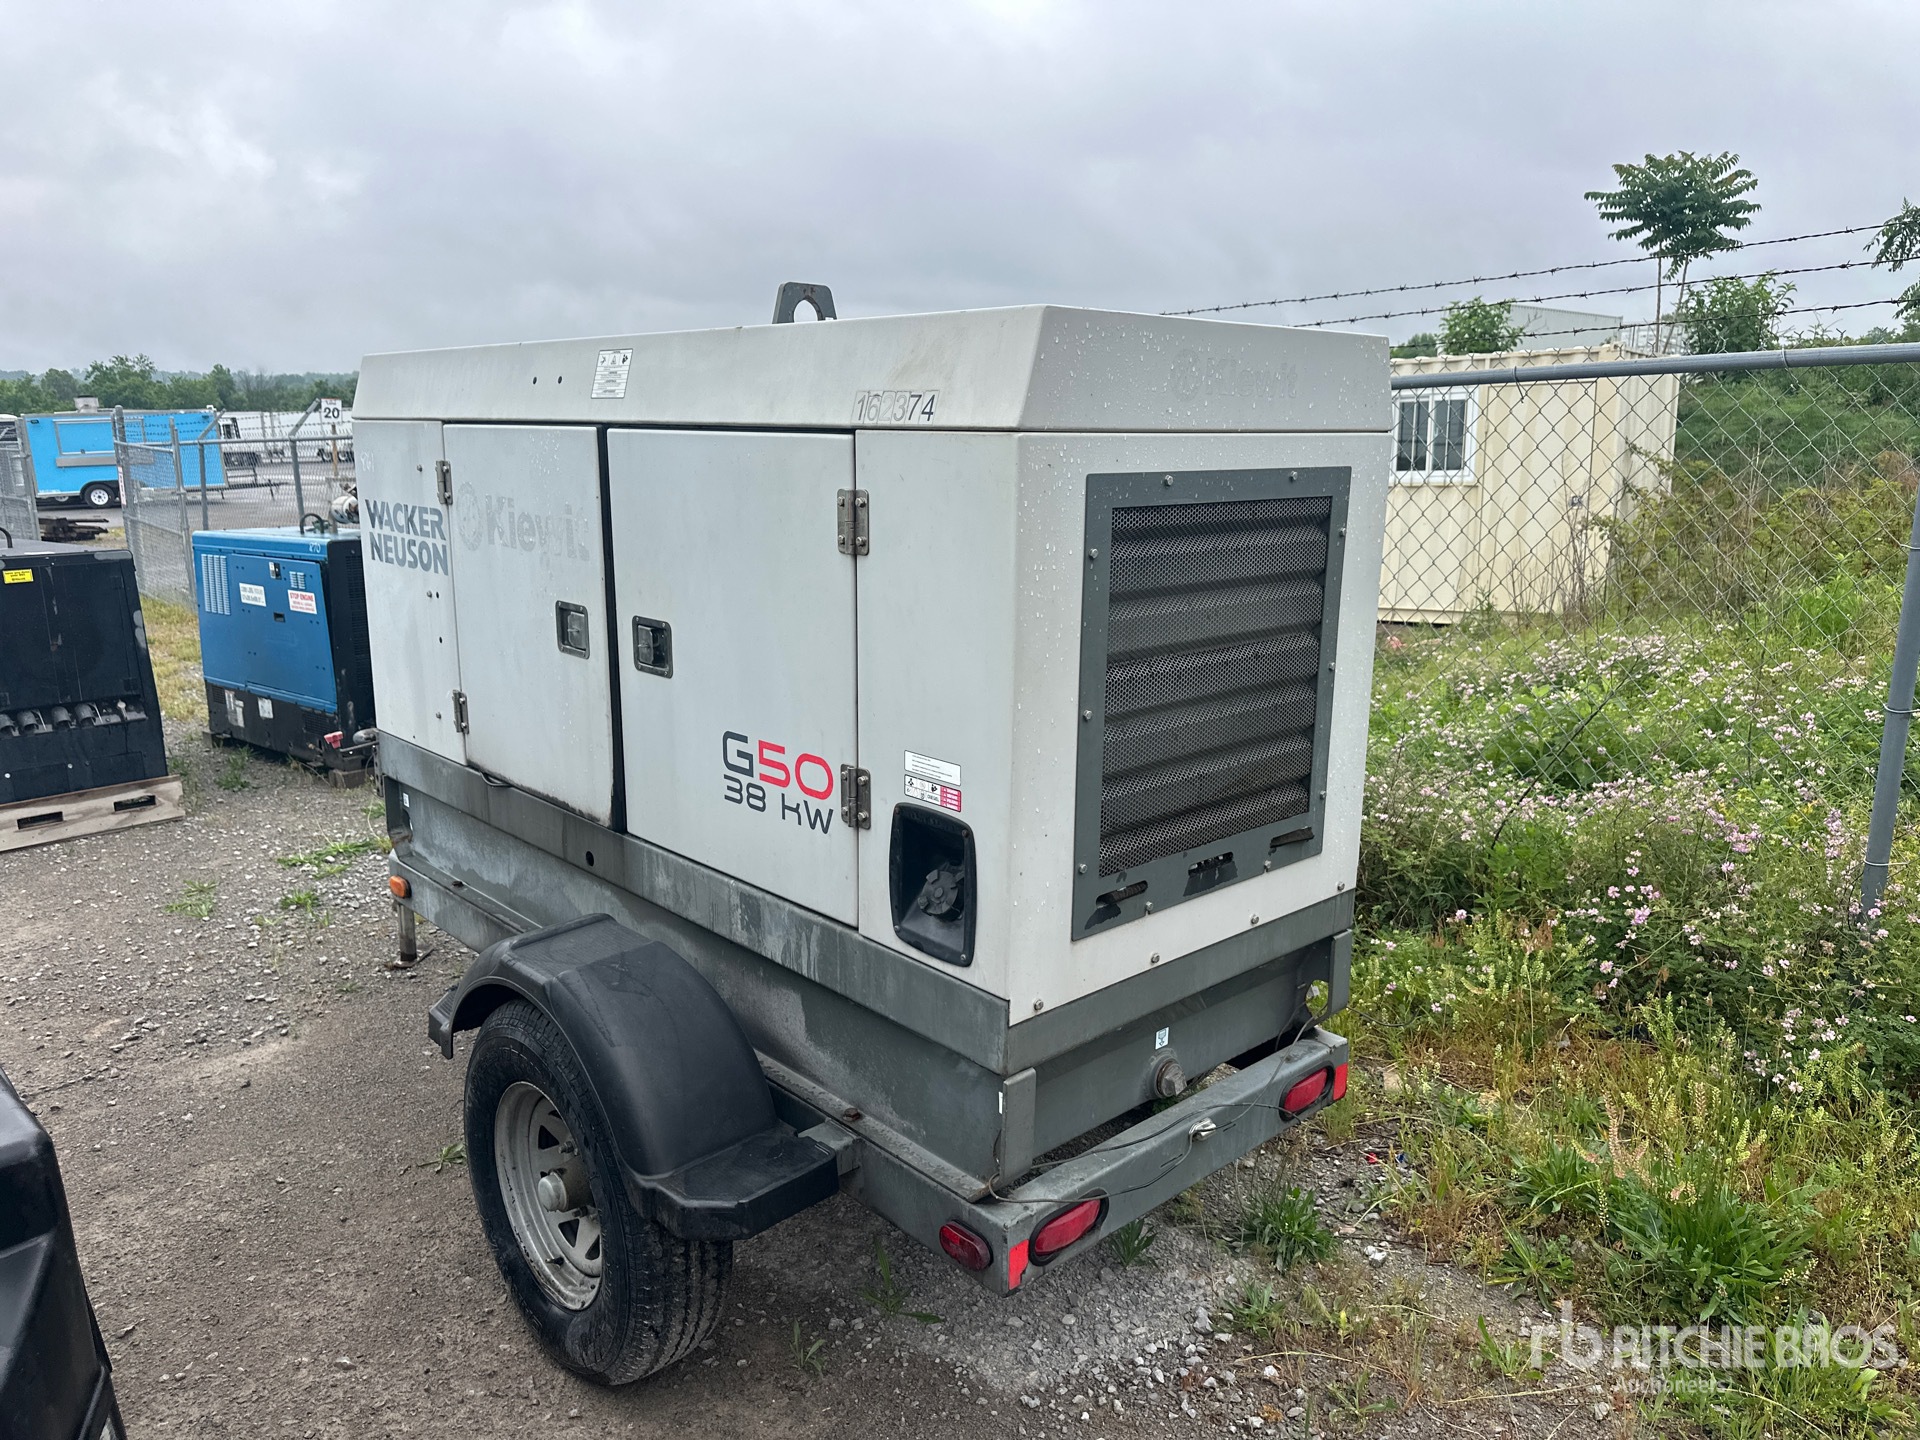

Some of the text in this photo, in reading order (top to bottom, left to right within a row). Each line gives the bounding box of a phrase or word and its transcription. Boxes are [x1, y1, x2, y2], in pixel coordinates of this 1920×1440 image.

[323, 407, 340, 419] 20
[857, 393, 936, 422] 162374
[365, 499, 446, 541] WACKER
[369, 531, 449, 576] NEUSON
[290, 592, 314, 602] STOP ENGINE
[722, 730, 834, 801] G50
[723, 773, 834, 835] 38 kW
